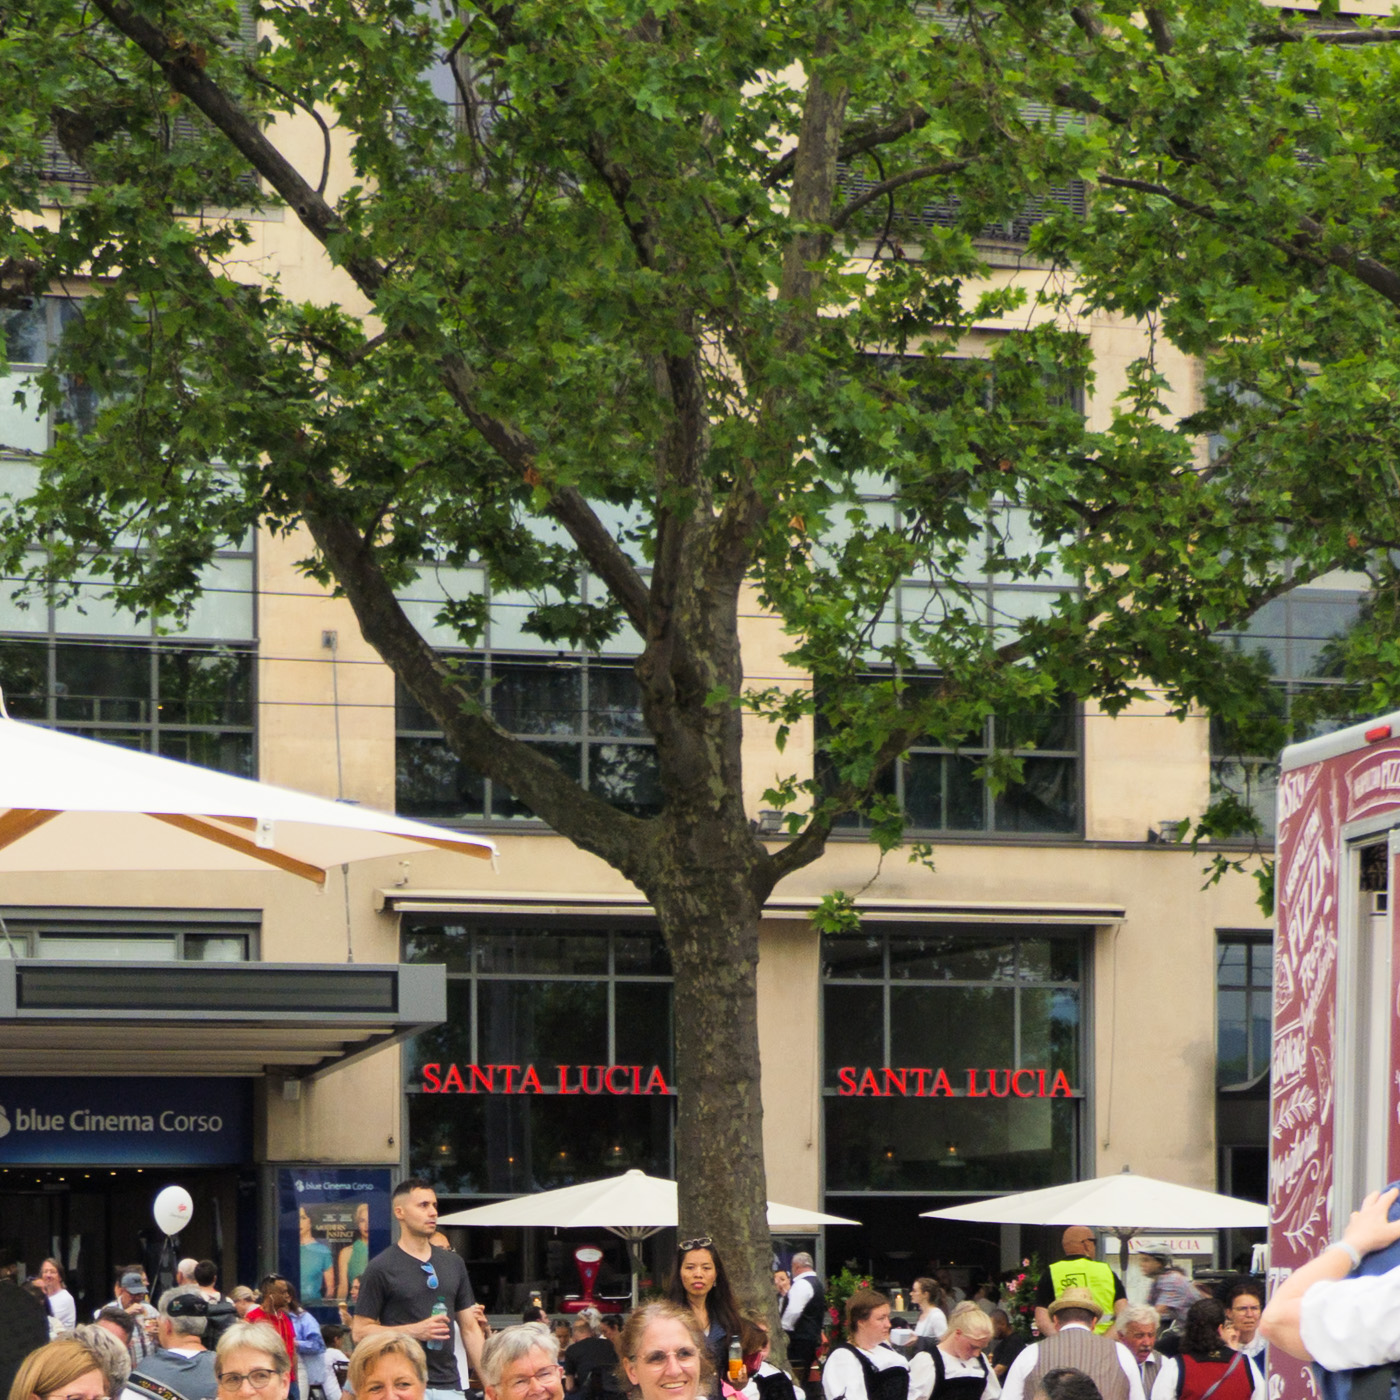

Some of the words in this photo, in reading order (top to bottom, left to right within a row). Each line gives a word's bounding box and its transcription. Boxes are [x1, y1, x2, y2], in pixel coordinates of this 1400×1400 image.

[422, 1063, 544, 1094] SANTA
[555, 1064, 671, 1095] LUCIA
[838, 1067, 955, 1097] SANTA
[966, 1068, 1074, 1098] LUCIA
[16, 1108, 65, 1131] blue
[69, 1109, 154, 1132] Cinema
[159, 1111, 223, 1132] Corso
[305, 1181, 322, 1191] blue
[323, 1181, 352, 1191] Cinema
[352, 1182, 375, 1191] Corso
[1162, 1239, 1200, 1251] UCIA
